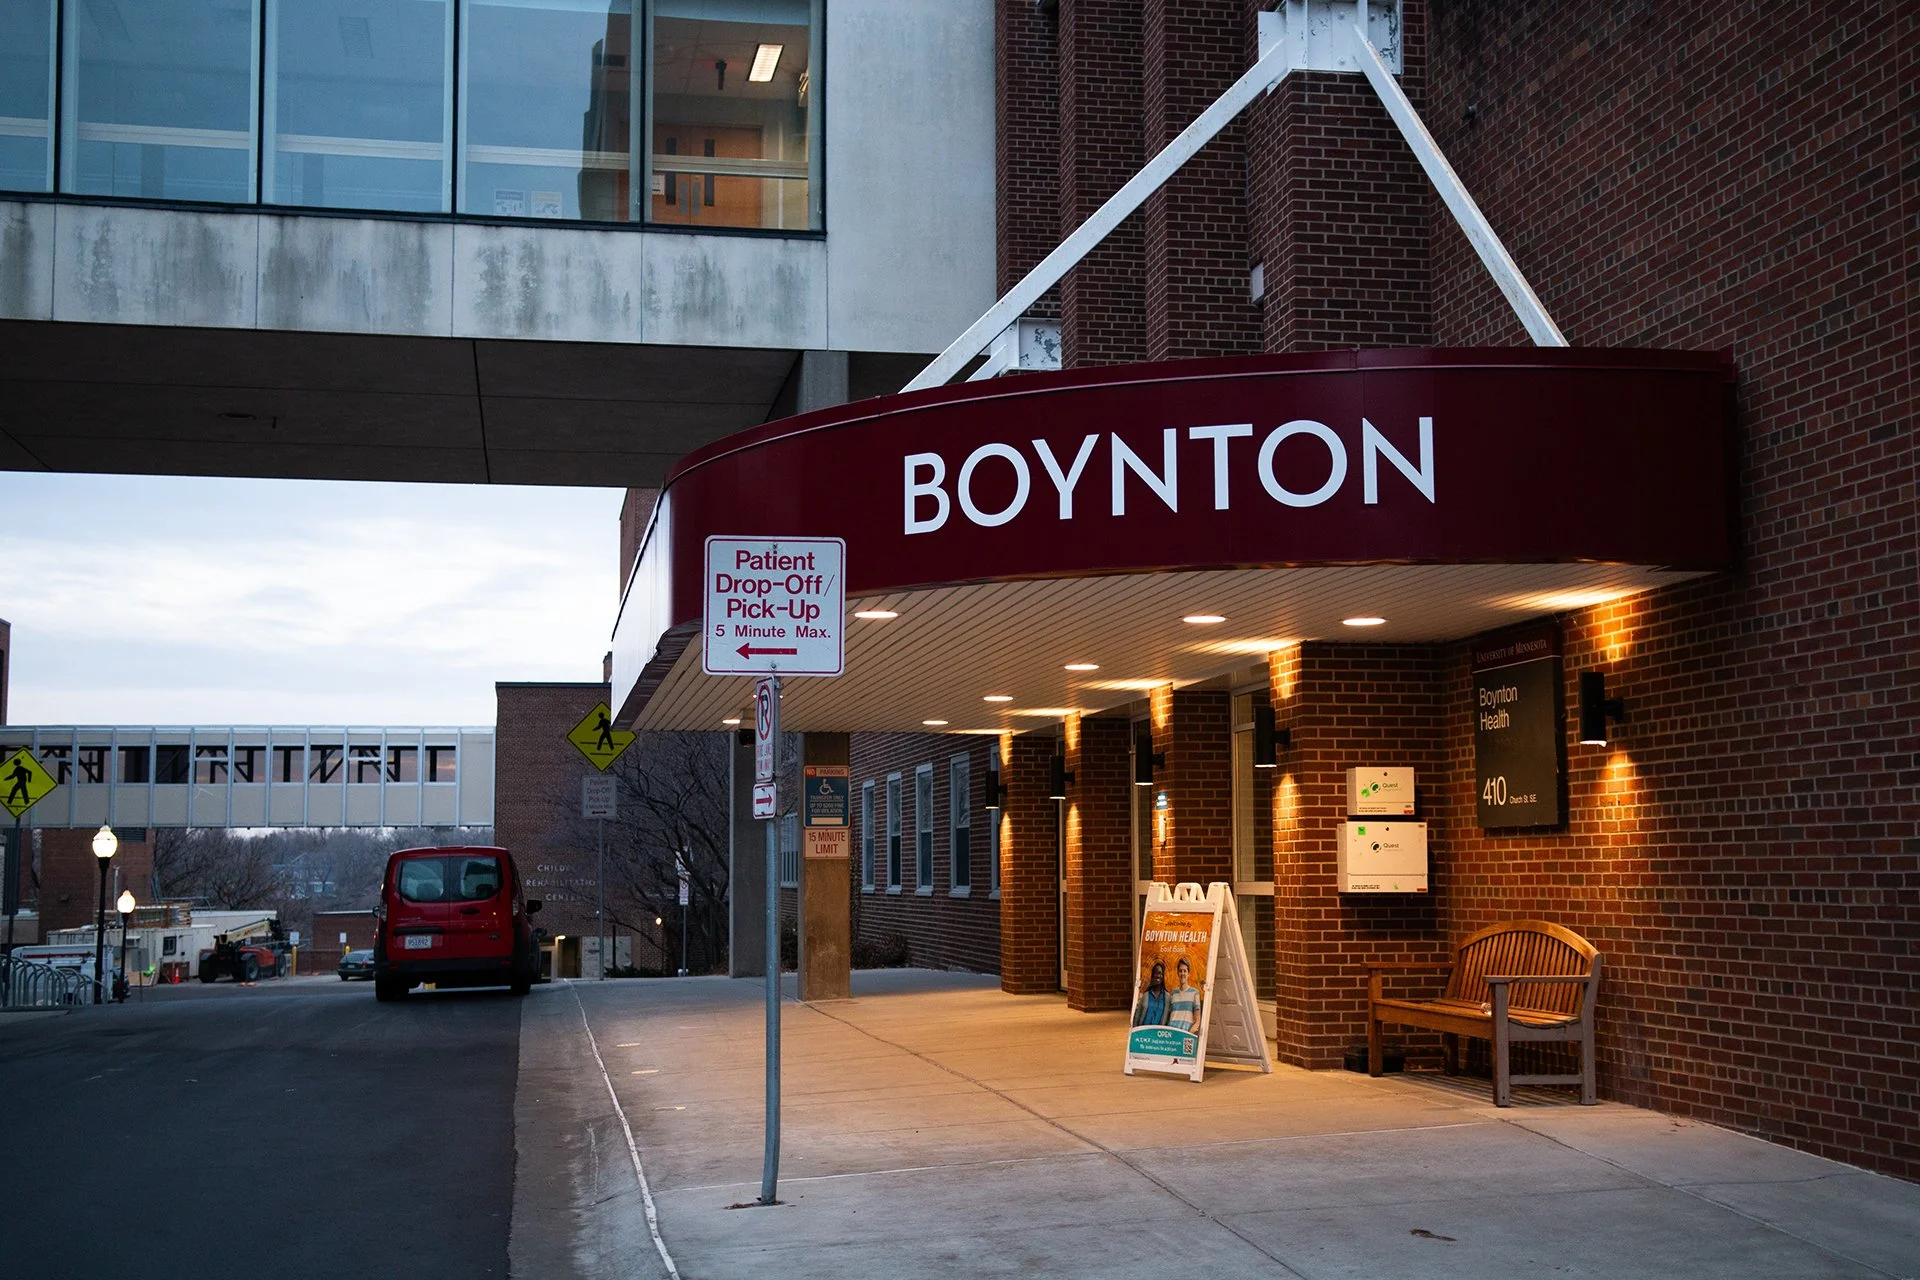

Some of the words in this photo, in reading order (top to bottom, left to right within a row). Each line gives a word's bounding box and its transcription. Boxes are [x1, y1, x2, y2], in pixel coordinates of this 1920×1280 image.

[904, 416, 1435, 535] BOYNTON
[735, 549, 815, 571] Patient
[726, 598, 820, 623] Pick-Up
[715, 624, 725, 637] 5
[735, 624, 786, 638] Minute
[795, 625, 831, 638] Max.
[1479, 685, 1518, 709] Boynton
[1480, 709, 1510, 730] Health
[806, 768, 816, 776] NO
[818, 768, 846, 776] PARKING
[1483, 775, 1507, 806] 410
[808, 831, 816, 842] 15
[818, 831, 846, 842] MINUTE
[815, 844, 838, 854] LIMIT
[1145, 930, 1178, 942] BOYNTON
[1178, 930, 1208, 943] HEALTH
[1160, 944, 1172, 953] East
[1172, 944, 1186, 953] Bank
[1157, 1030, 1172, 1038] OPEN
